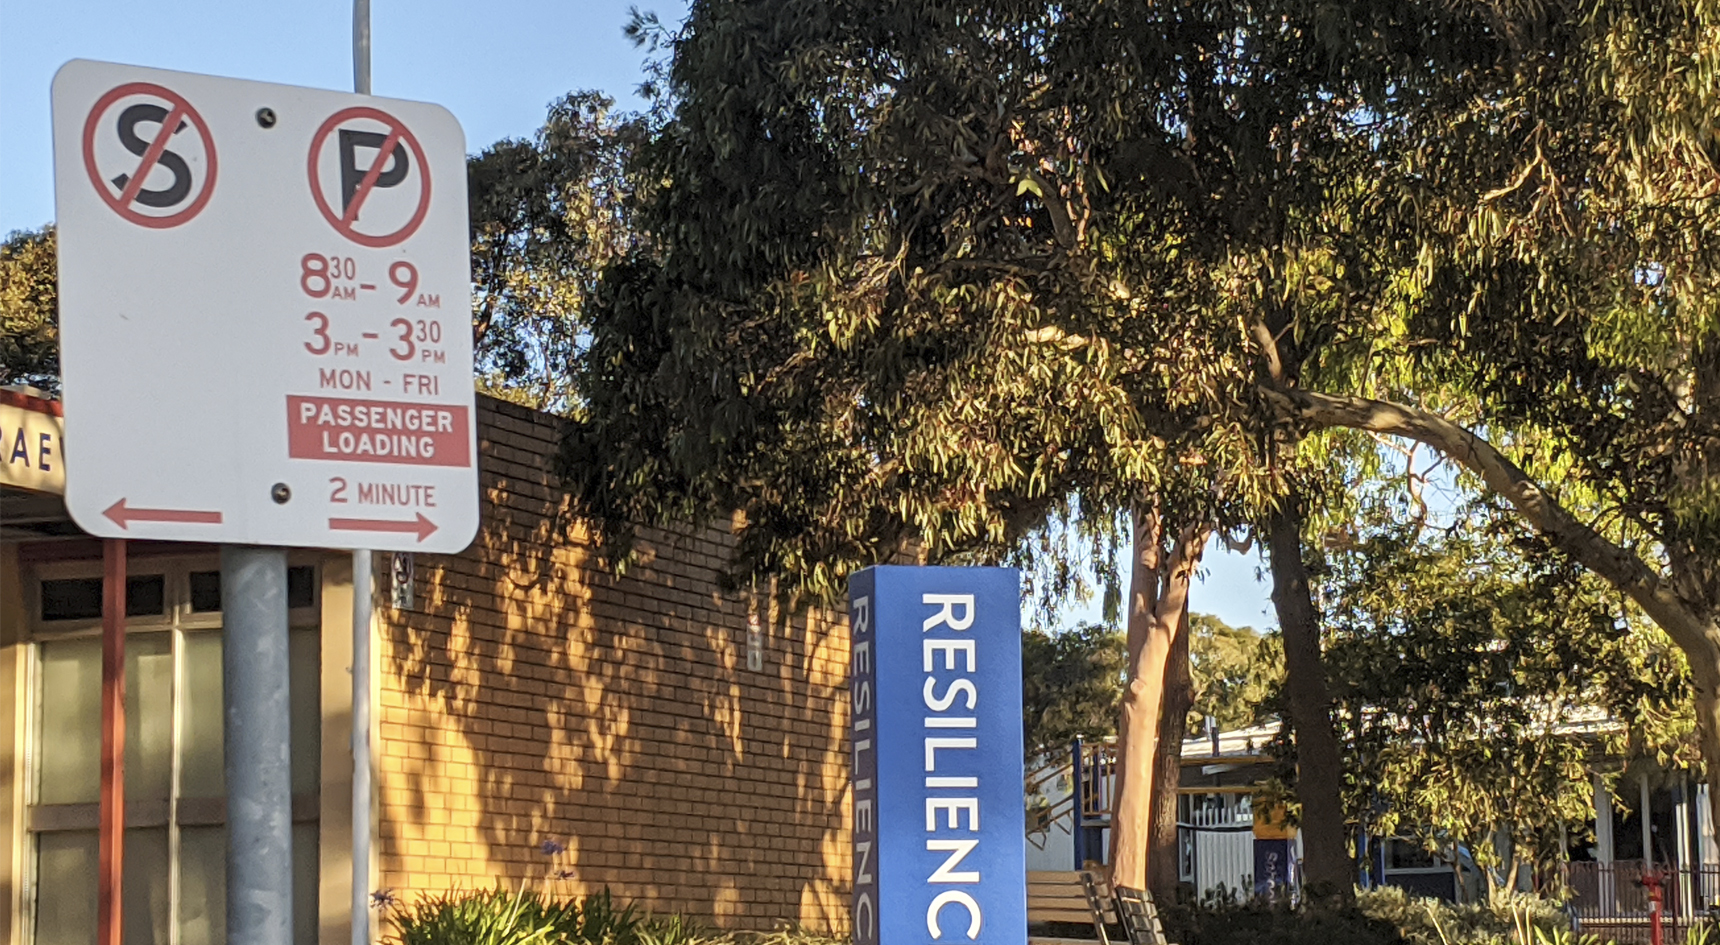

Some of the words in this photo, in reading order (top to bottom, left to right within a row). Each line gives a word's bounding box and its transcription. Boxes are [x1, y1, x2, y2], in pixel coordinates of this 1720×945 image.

[111, 103, 192, 208] S
[338, 128, 409, 221] P
[301, 253, 331, 299] 8
[330, 256, 355, 281] 30
[388, 261, 419, 305] 9
[331, 286, 355, 300] AM
[416, 294, 440, 308] AM
[304, 311, 331, 355] 3
[389, 318, 416, 361] 3
[416, 319, 441, 343] 30
[334, 342, 359, 357] PM
[421, 350, 445, 364] PM
[319, 368, 371, 391] MON
[403, 373, 439, 395] FRI
[300, 402, 453, 432] PASSENGER
[322, 431, 435, 458] LOADING
[329, 477, 348, 503] 2
[358, 482, 436, 507] MINUTE
[922, 594, 981, 940] RESILIENC
